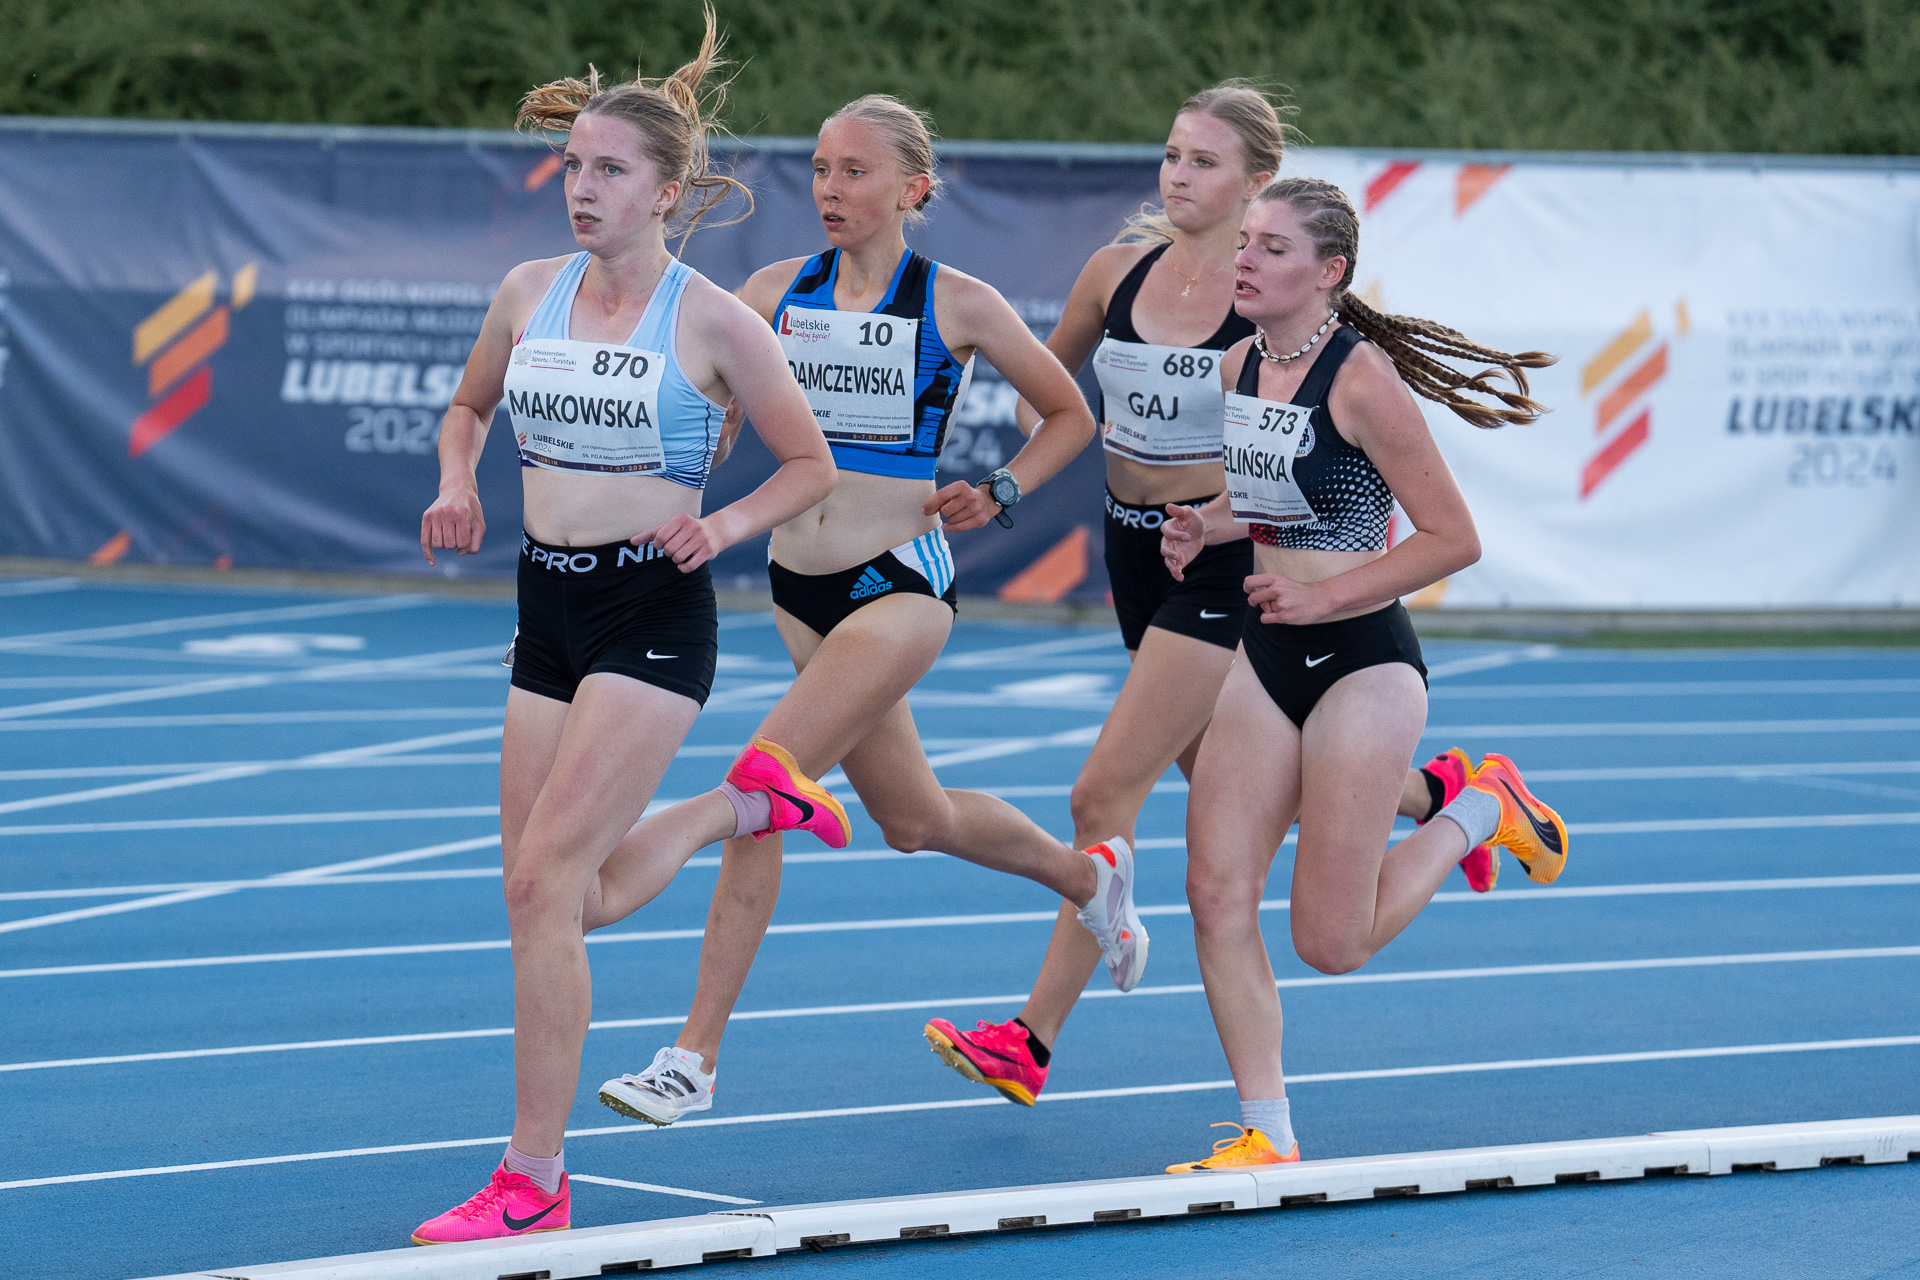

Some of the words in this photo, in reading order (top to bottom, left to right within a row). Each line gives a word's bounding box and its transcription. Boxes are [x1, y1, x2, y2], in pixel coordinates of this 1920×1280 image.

[859, 321, 893, 346] 10
[533, 349, 566, 357] Ministerstwo
[553, 358, 577, 366] Turystyki
[592, 350, 649, 379] 870
[1163, 353, 1213, 378] 689
[508, 389, 652, 429] MAKOWSKA
[1128, 392, 1179, 421] GAJ
[1116, 423, 1147, 442] LUBELSKIE
[1259, 407, 1298, 435] 573
[532, 433, 575, 450] LUBELSKIE
[533, 441, 552, 453] 2024
[852, 433, 898, 441] 5-7.07.2024
[1223, 443, 1290, 483] ELIŃSKA
[1112, 502, 1164, 529] PRO
[532, 545, 598, 573] PRO
[617, 540, 666, 568] NI
[850, 581, 893, 600] adidas
